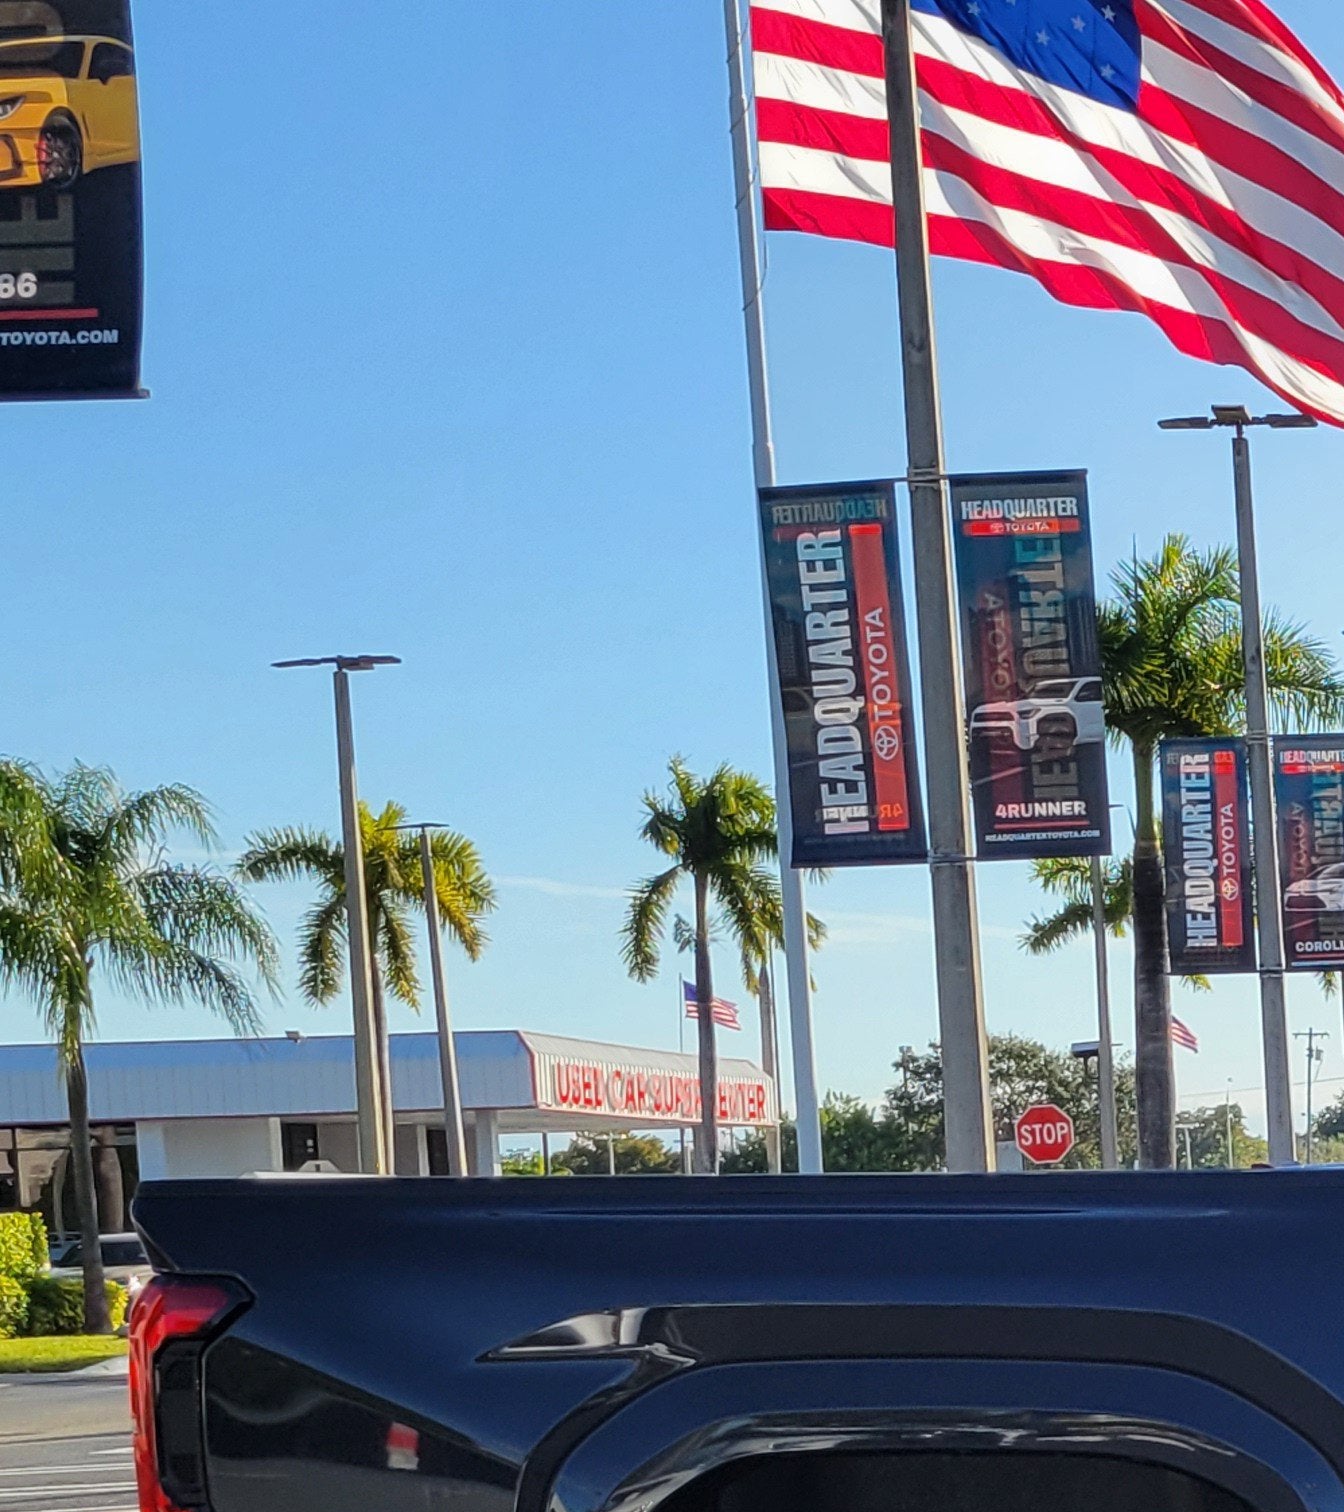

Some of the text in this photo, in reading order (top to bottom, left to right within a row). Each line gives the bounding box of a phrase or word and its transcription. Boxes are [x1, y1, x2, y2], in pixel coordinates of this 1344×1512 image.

[0, 272, 38, 299] 86
[961, 497, 1079, 520] HEADQUARTER
[1005, 522, 1050, 531] TOYOTA
[797, 528, 870, 835] HEADQUARTER
[864, 607, 892, 722] TOYOTA
[995, 801, 1087, 818] 4RUNNER
[1180, 753, 1218, 947] HEADQUARTER
[1220, 803, 1237, 877] TOYOTA
[556, 1063, 605, 1108] USED
[608, 1069, 647, 1111] CAR
[718, 1083, 766, 1119] ENTER
[1020, 1122, 1068, 1146] STOP
